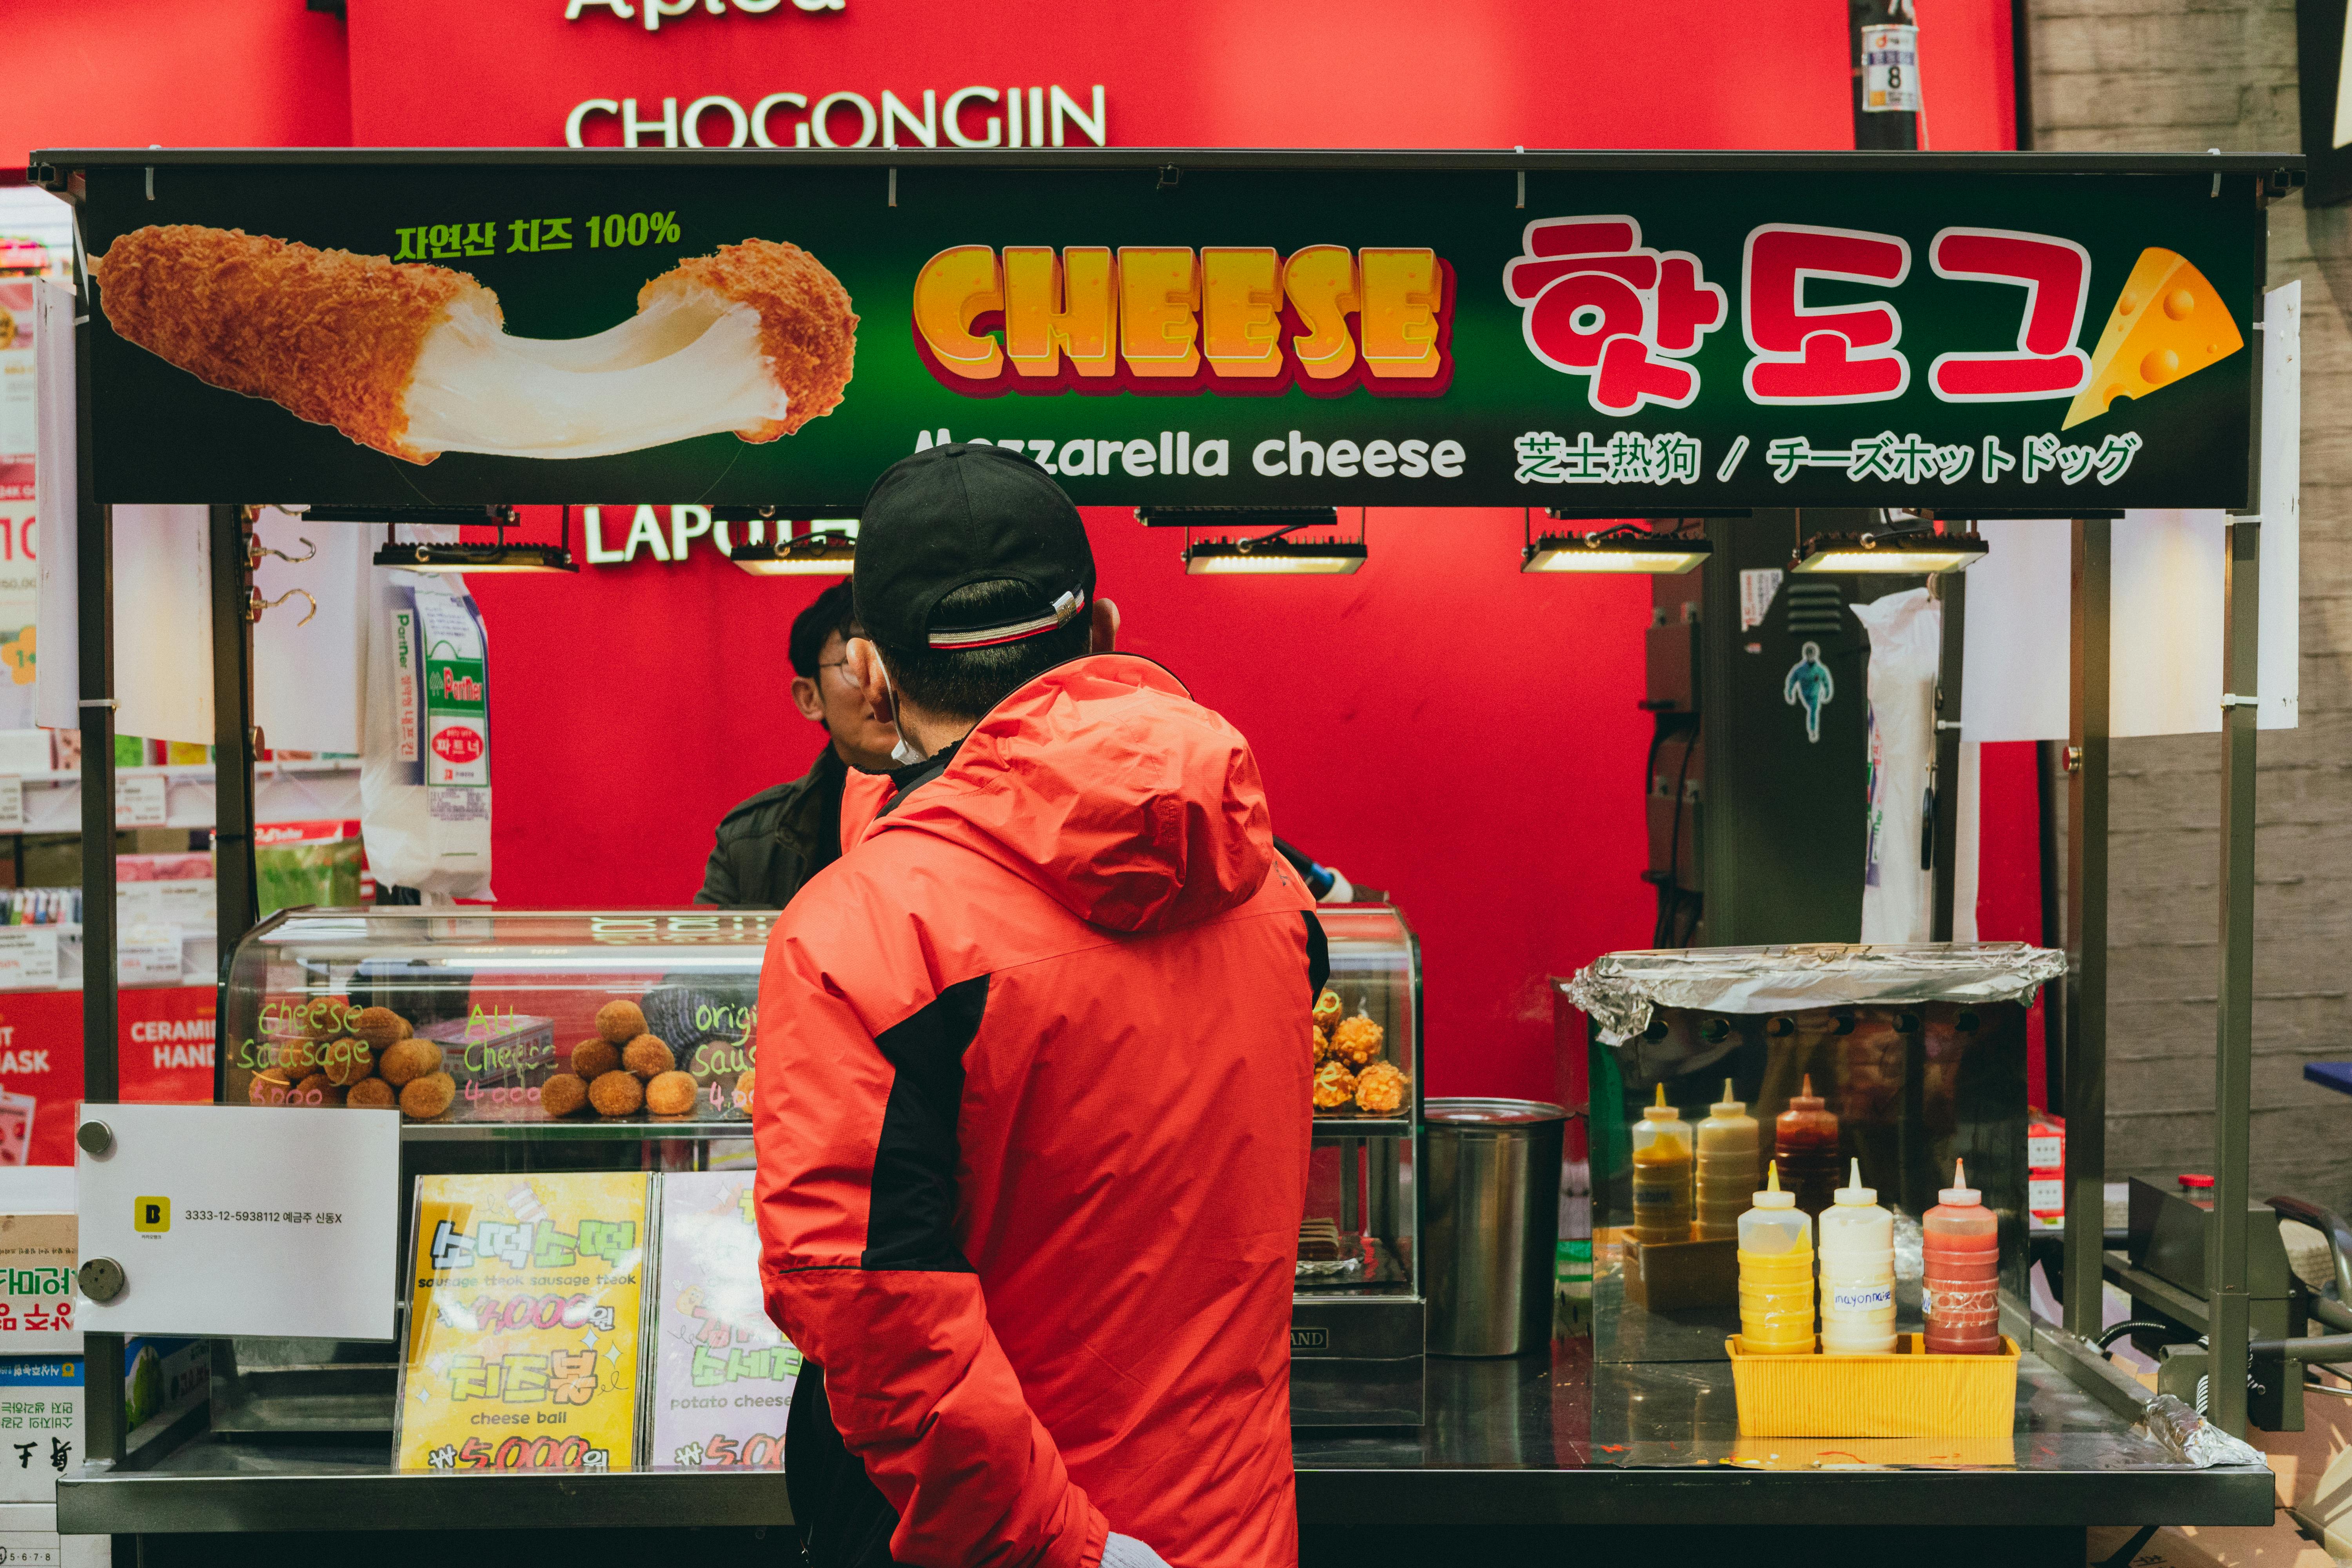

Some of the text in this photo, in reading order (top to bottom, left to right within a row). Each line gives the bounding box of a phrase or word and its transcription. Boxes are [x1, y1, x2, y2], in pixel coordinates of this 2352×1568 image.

[394, 211, 681, 262] 자연산 치즈 100%
[912, 244, 1457, 398] CHEESE
[1252, 430, 1466, 477] cheese
[1516, 432, 1702, 484] 芝士热狗
[1766, 430, 2143, 485] チーズホットドッグ
[185, 1210, 342, 1224] 3333-12-5938112 예금주 신동X
[431, 1219, 636, 1270] 소떡소떡
[418, 1273, 636, 1288] sausage tteok sausage tteok
[447, 1349, 599, 1406] 치즈볼
[51, 1402, 73, 1414] 먼저
[671, 1395, 728, 1410] potato
[29, 1417, 73, 1429] 소비자의
[470, 1412, 567, 1425] cheese ball
